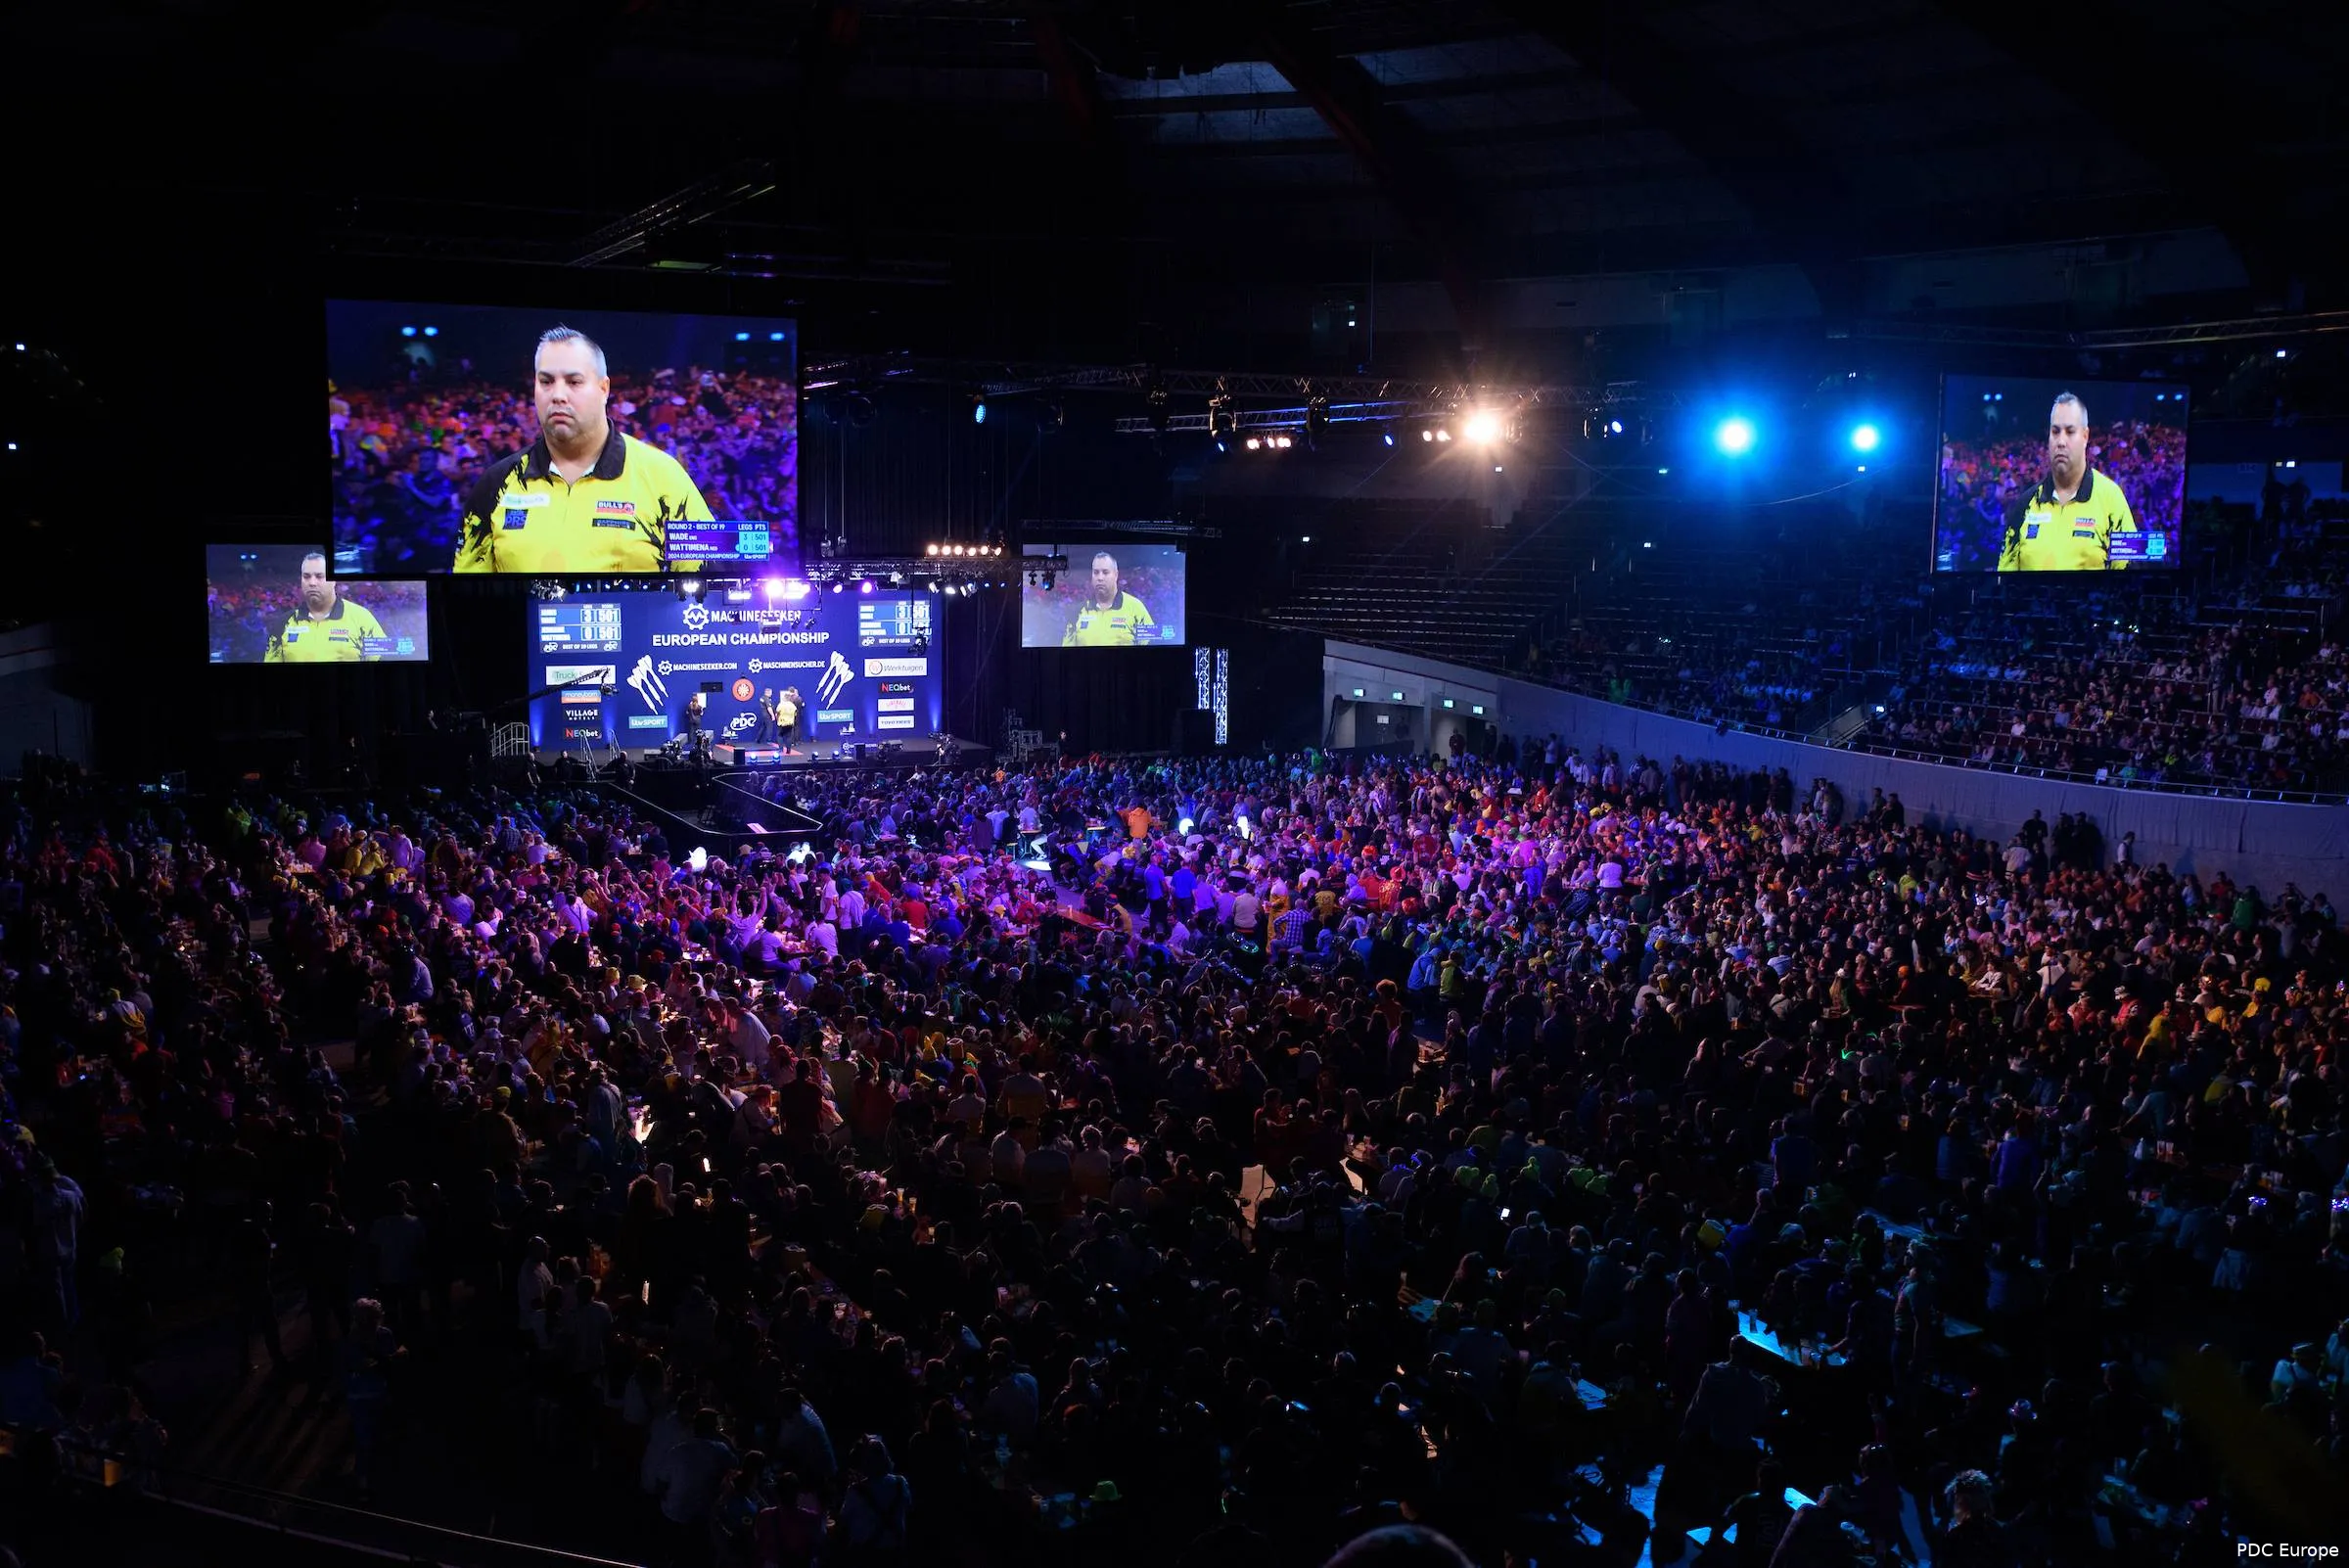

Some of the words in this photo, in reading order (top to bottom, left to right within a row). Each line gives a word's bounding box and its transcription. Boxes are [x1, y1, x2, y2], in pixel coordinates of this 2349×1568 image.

[584, 609, 592, 623] 3
[598, 609, 619, 623] 501
[653, 634, 727, 646] EUROPEAN
[730, 632, 830, 645] CHAMPIONSHIP
[672, 663, 738, 671] MACHINESEEKER.COM
[762, 661, 825, 669] MASCHINENSUCHER.DE
[884, 665, 924, 673] Werktuigen
[732, 715, 756, 728] PDC
